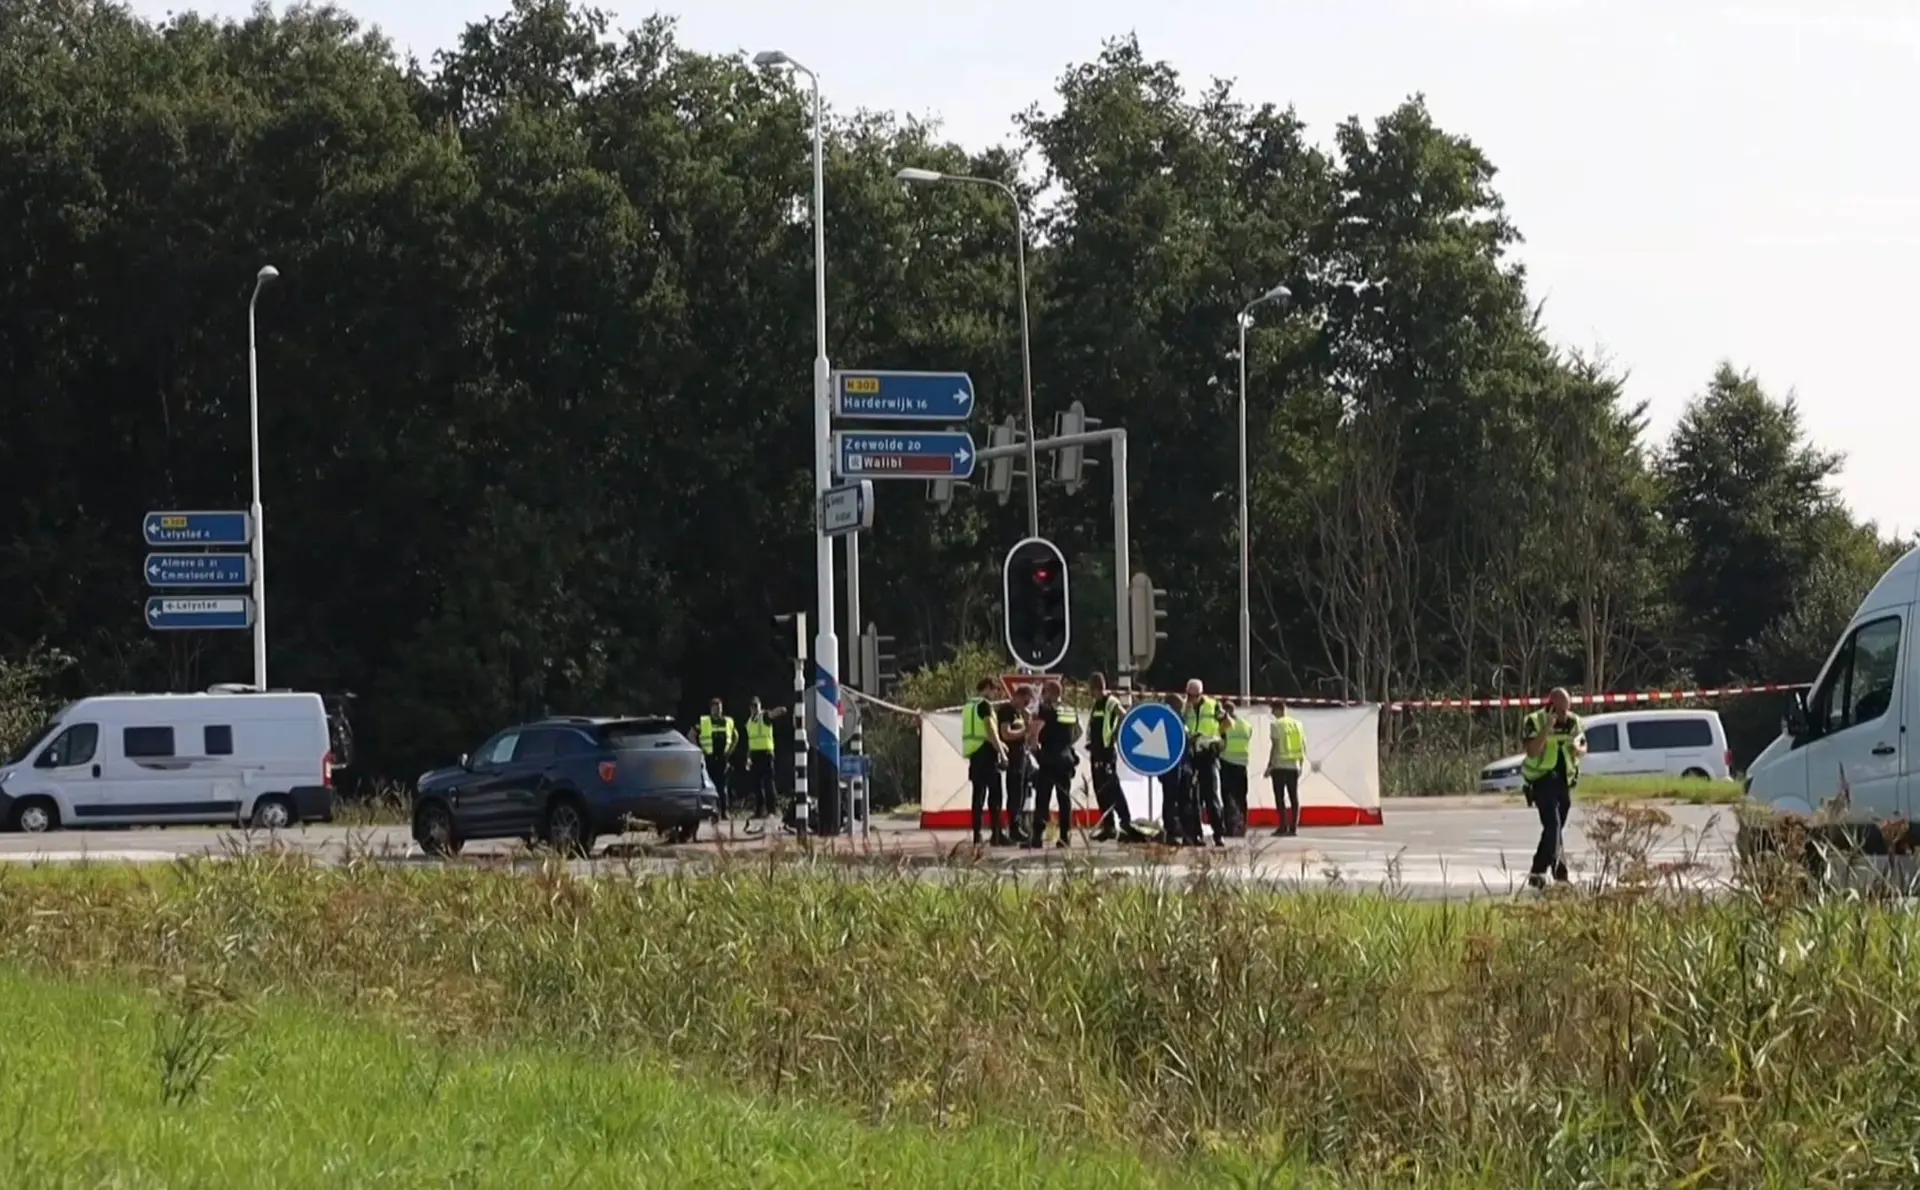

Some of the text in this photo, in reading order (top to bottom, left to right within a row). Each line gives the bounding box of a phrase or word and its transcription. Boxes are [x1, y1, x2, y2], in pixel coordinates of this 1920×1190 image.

[844, 396, 928, 412] Harderwijk 16
[845, 438, 922, 450] Zeewolde 20
[863, 456, 902, 468] Walibi
[160, 529, 202, 539] Lelystad
[161, 558, 196, 568] Almere
[161, 571, 215, 580] Emmeloord
[176, 601, 218, 610] Lelystad
